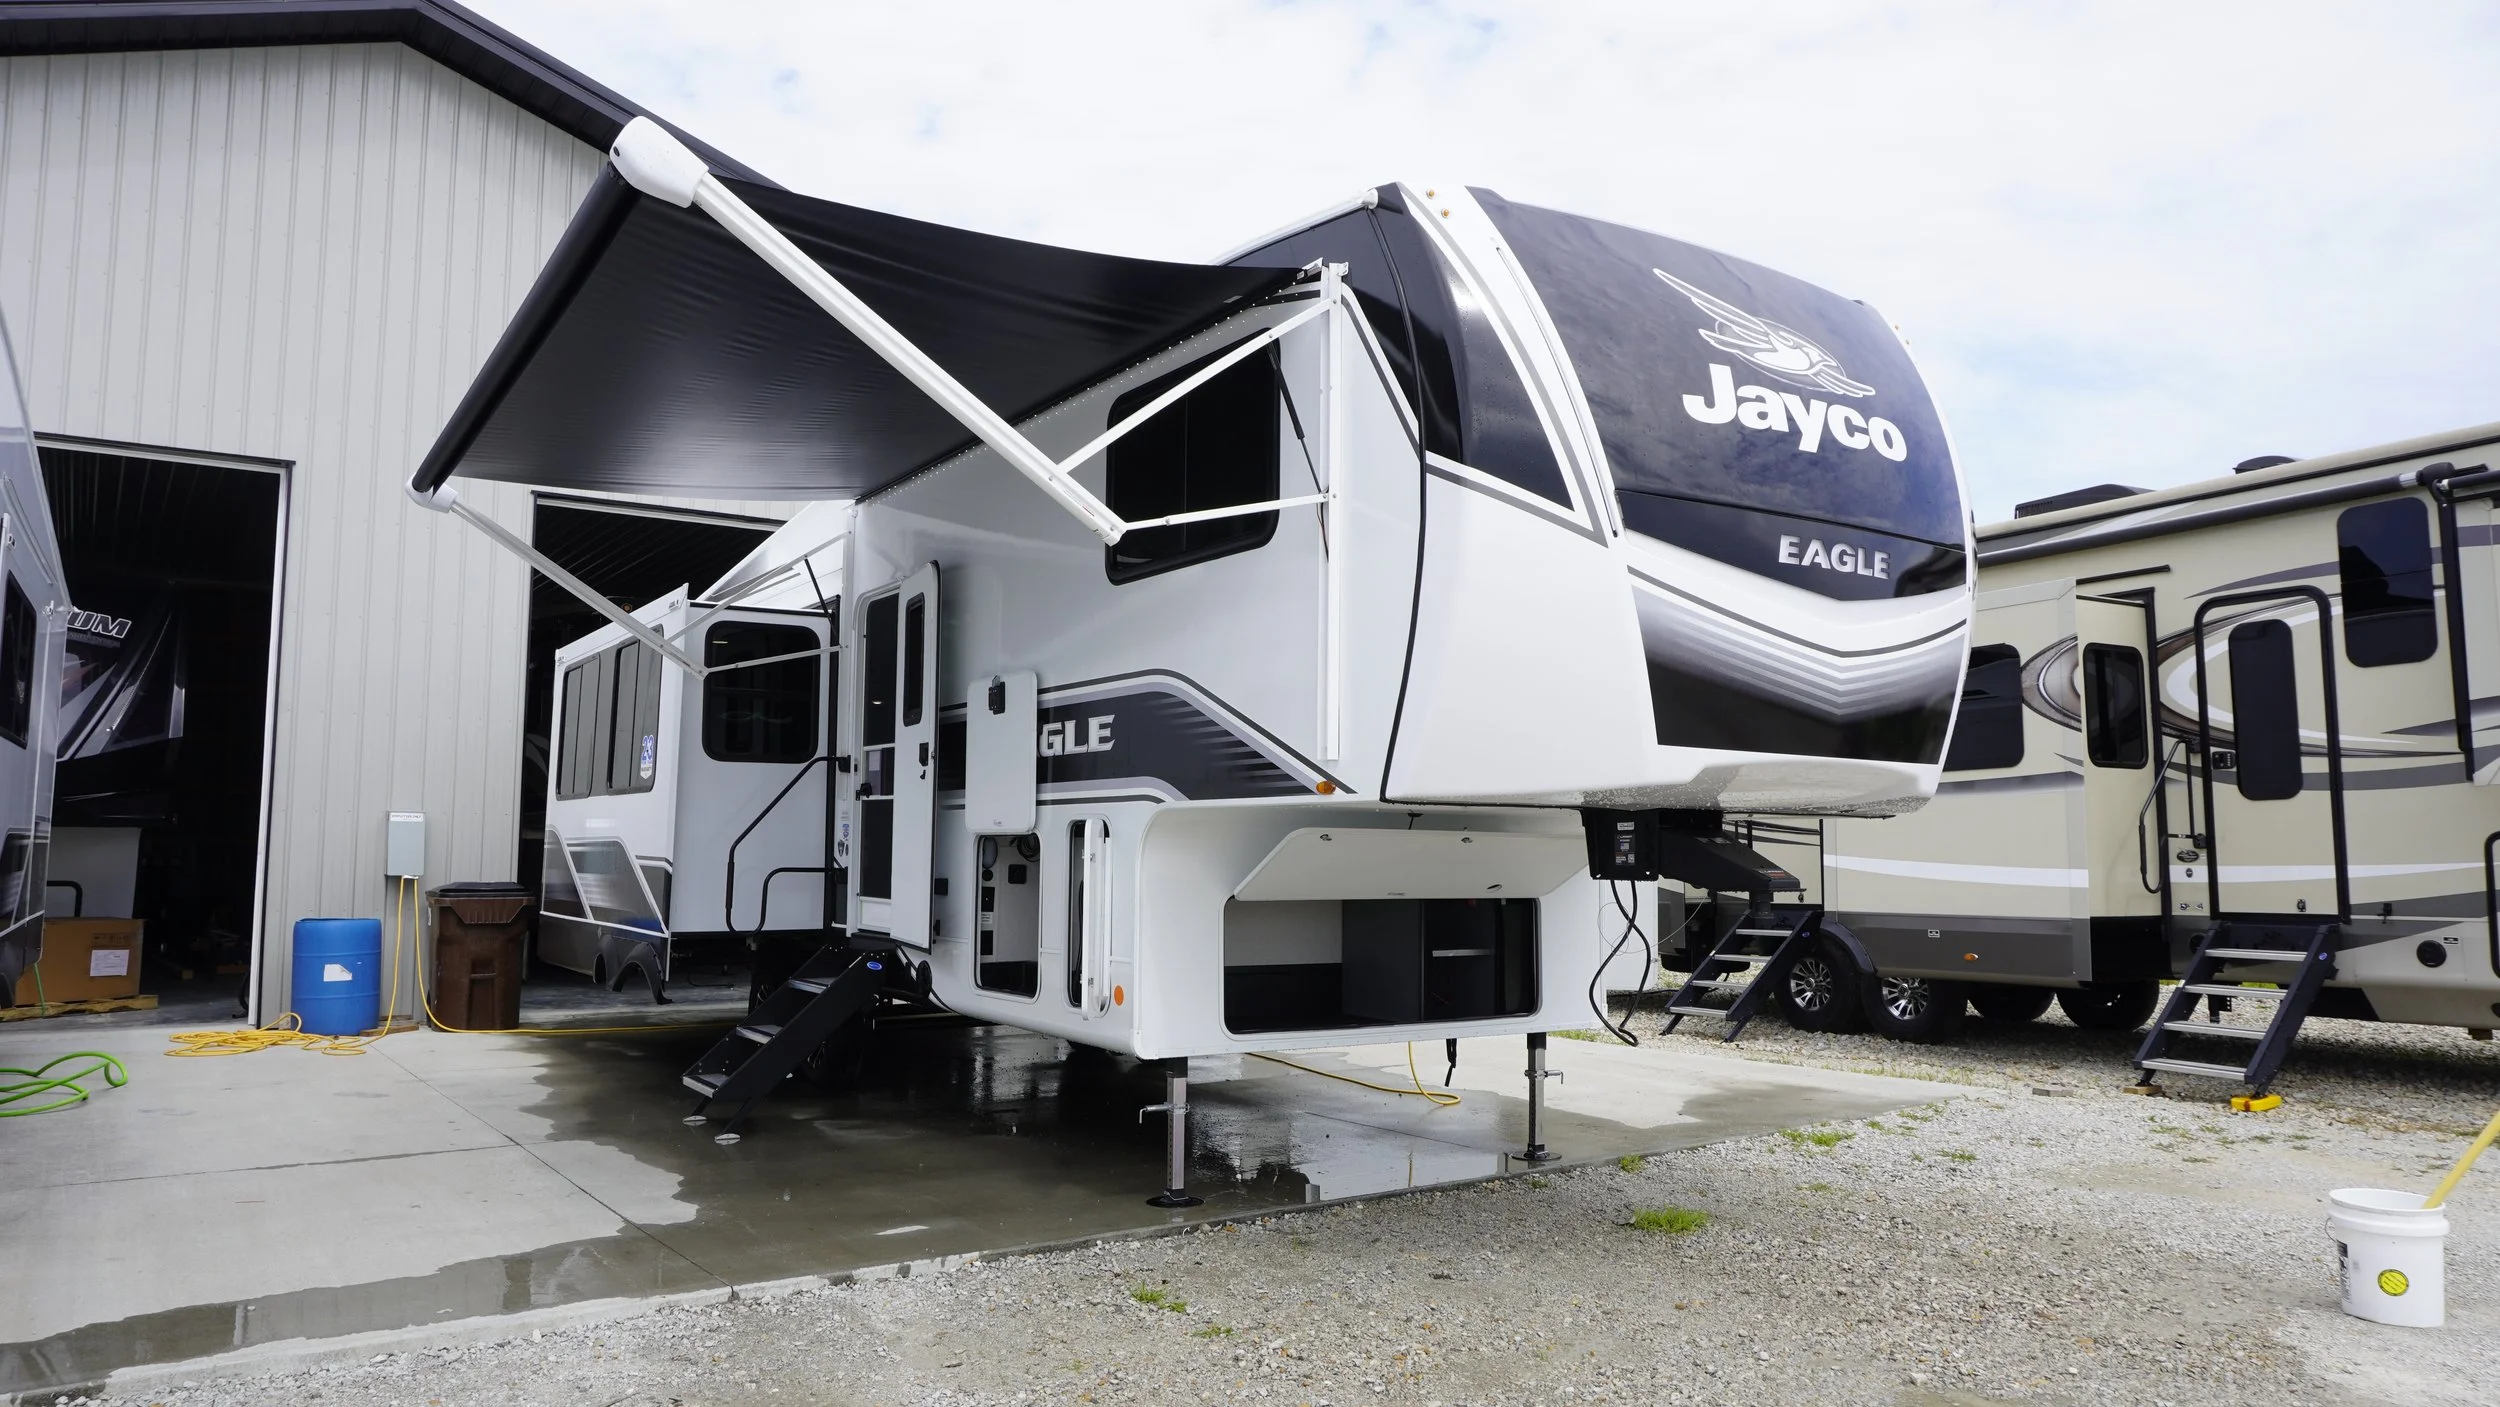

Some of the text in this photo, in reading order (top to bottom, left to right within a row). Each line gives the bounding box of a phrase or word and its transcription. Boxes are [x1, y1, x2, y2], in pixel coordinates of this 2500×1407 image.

[1682, 363, 1907, 461] Jayco
[1778, 535, 1890, 579] EAGLE
[1039, 714, 1115, 757] GLE
